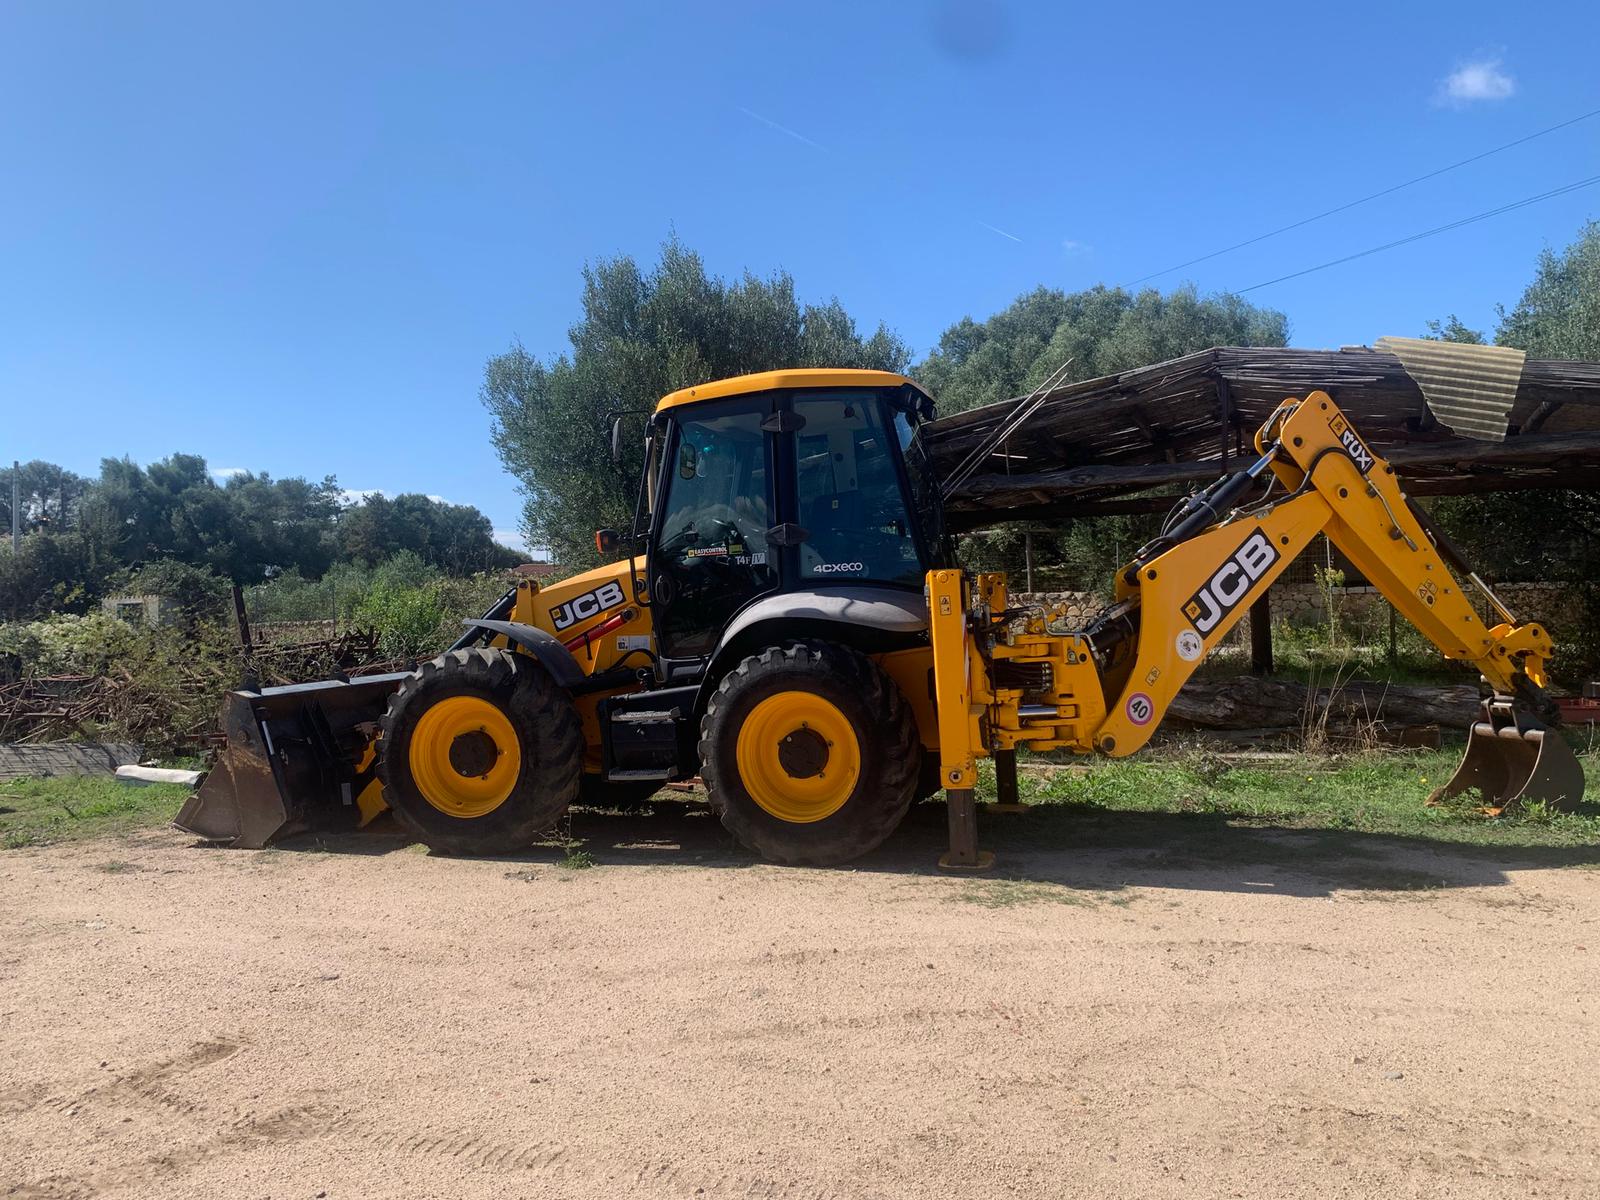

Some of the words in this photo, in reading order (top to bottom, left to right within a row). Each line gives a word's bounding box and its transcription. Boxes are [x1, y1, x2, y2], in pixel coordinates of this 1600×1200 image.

[1343, 430, 1372, 469] 4CX
[1195, 534, 1275, 632] JCB
[555, 583, 624, 629] JCB
[1131, 700, 1149, 719] 40
